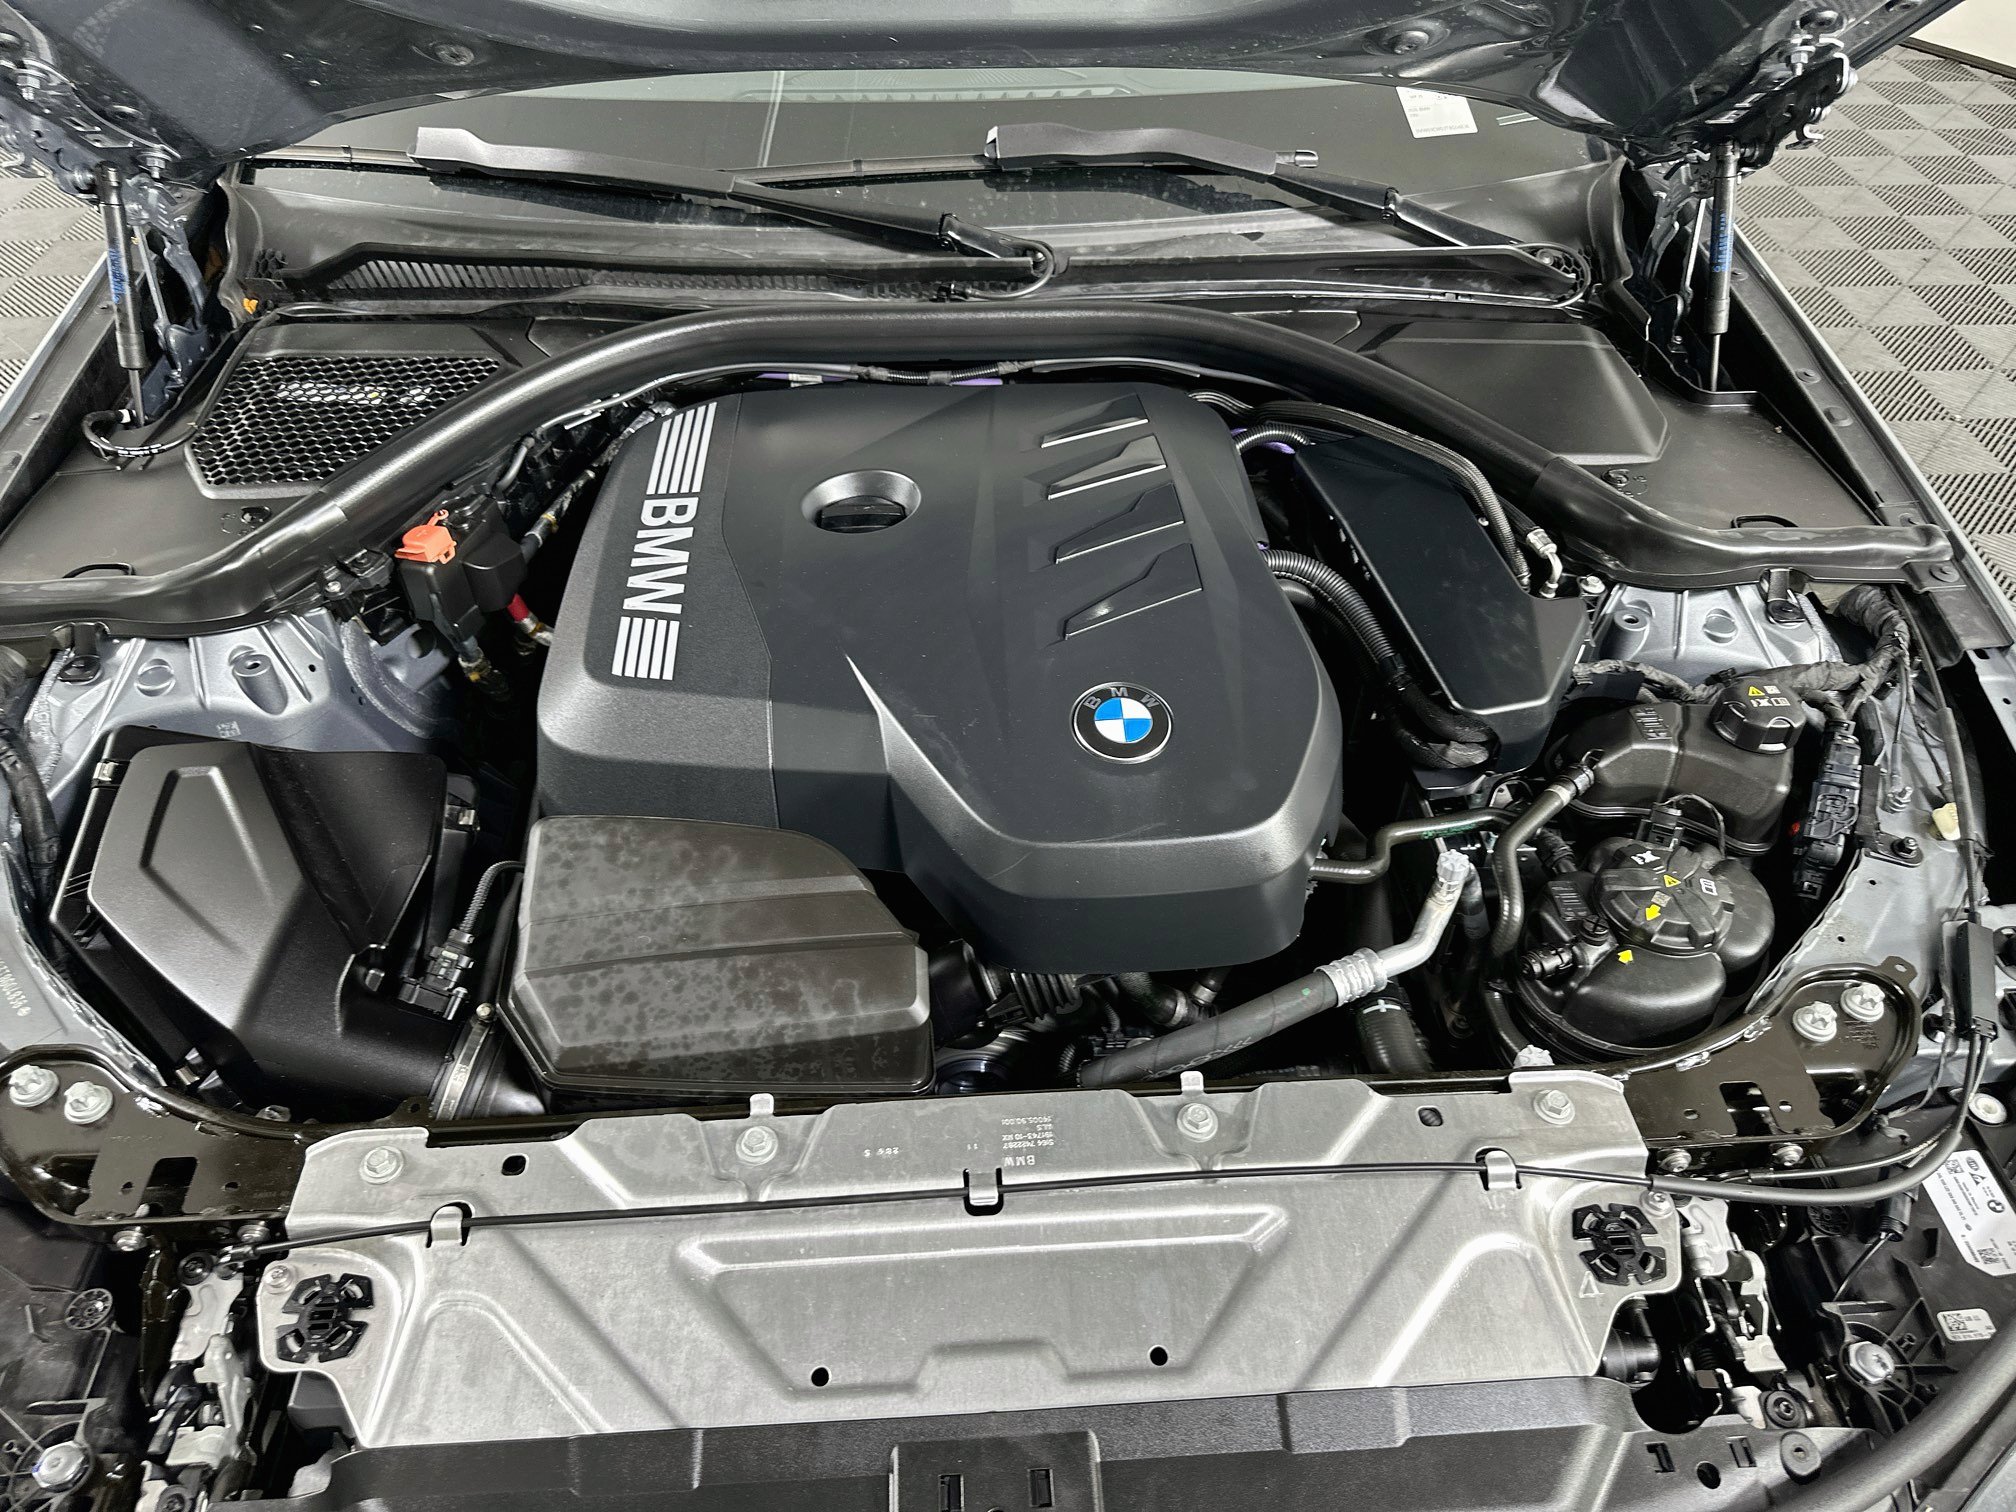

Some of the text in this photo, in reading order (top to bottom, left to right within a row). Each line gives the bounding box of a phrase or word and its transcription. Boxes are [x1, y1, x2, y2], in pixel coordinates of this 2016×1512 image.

[623, 497, 699, 614] BMW
[1083, 687, 1160, 710] BMW
[1003, 1155, 1036, 1167] BMW
